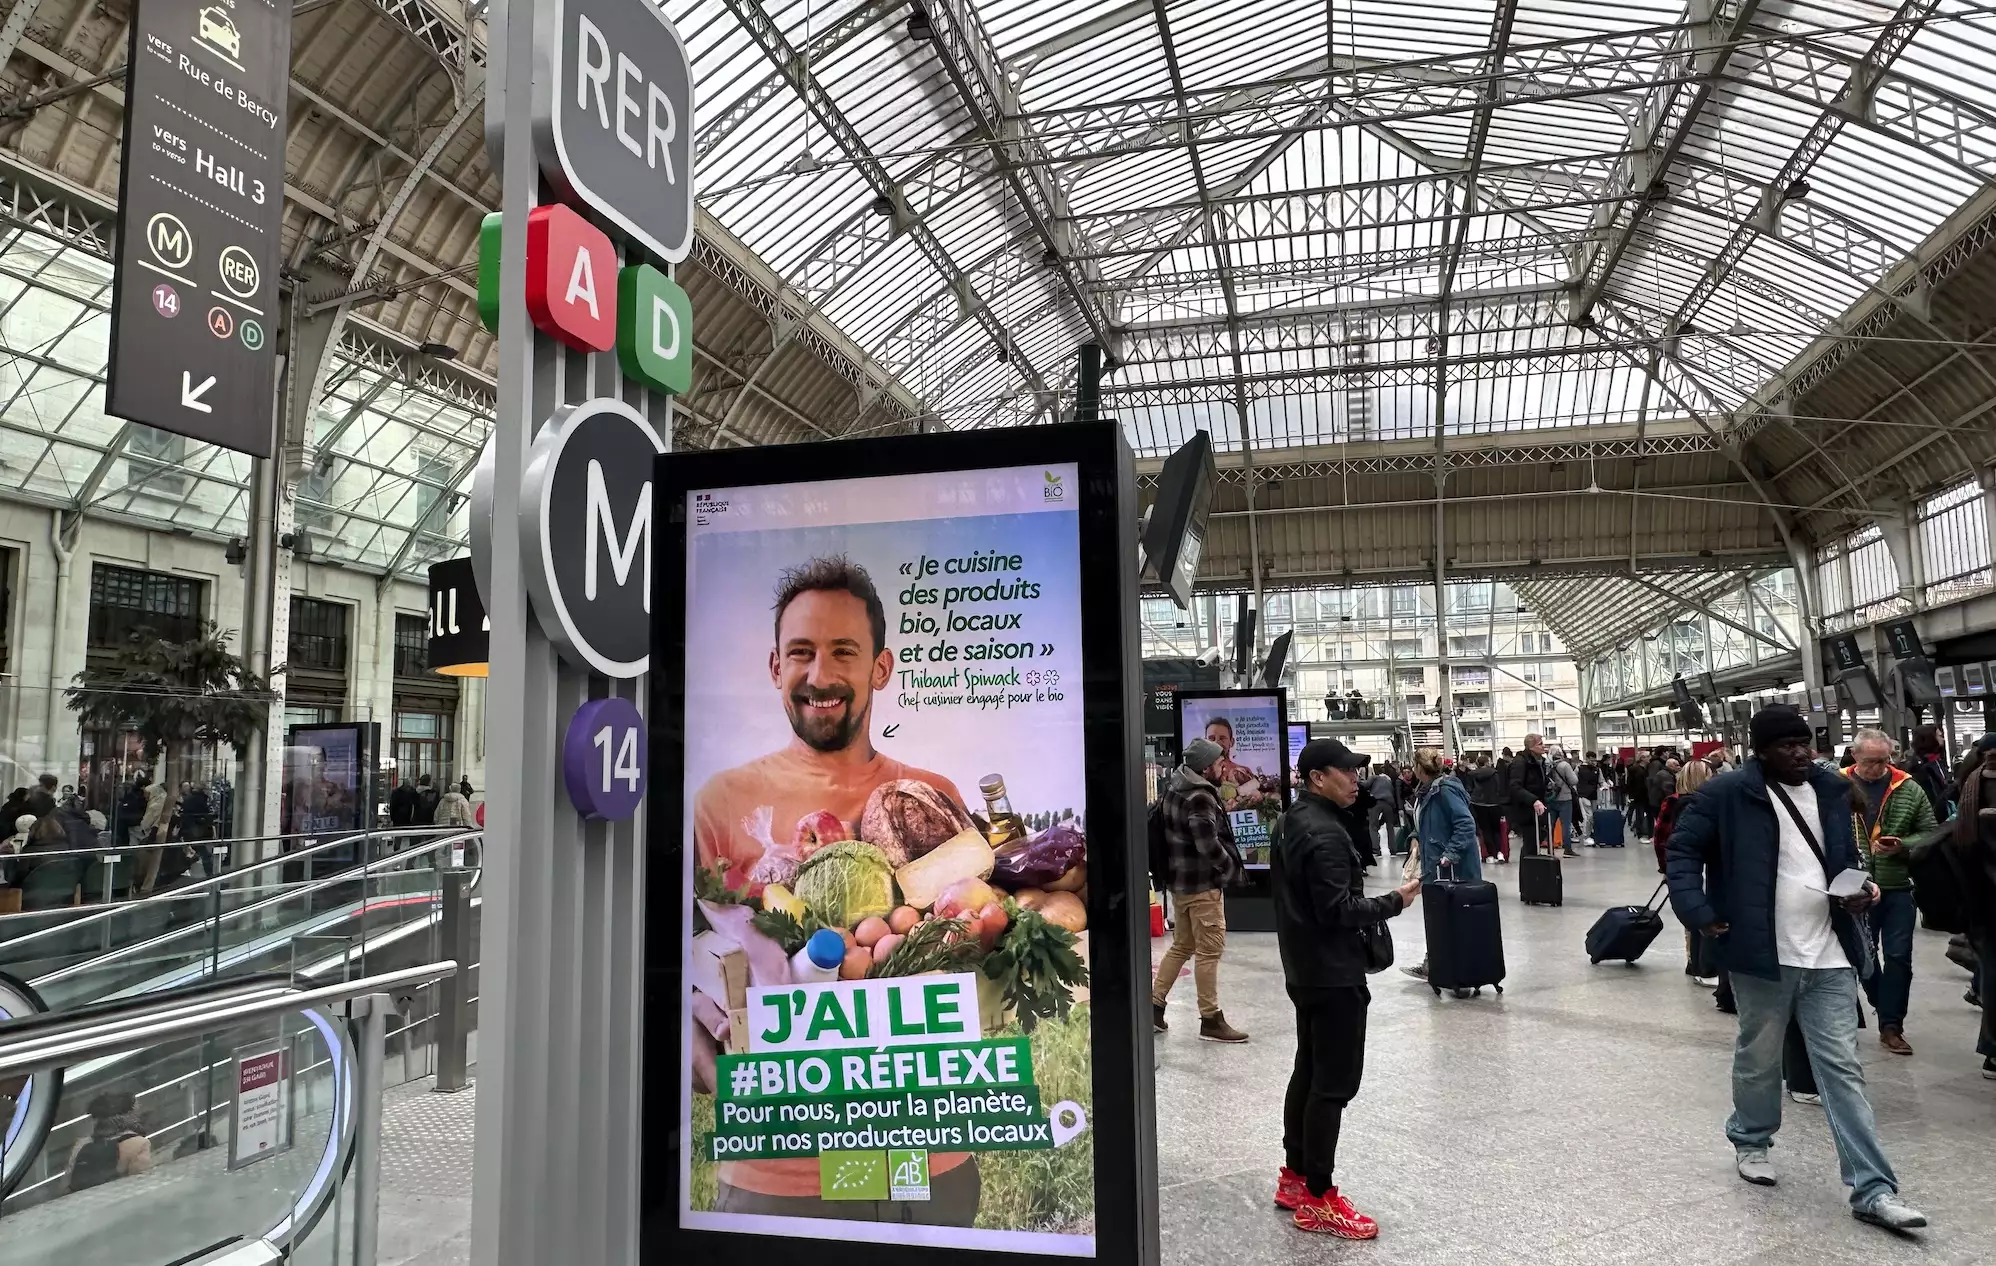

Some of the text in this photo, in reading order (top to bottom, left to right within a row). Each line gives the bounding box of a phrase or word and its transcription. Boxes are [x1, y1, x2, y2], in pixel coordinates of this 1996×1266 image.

[147, 33, 172, 54] vers
[179, 53, 278, 129] Rue de Bercy
[577, 13, 676, 186] RER
[153, 124, 187, 151] vers
[166, 150, 186, 165] verso
[196, 148, 265, 204] Hall 3
[157, 222, 182, 259] M
[225, 257, 255, 287] RER
[565, 245, 600, 321] A
[156, 289, 177, 313] 14
[214, 313, 227, 332] A
[246, 326, 258, 343] D
[653, 293, 680, 361] D
[585, 458, 652, 614] M
[914, 555, 940, 581] Je
[944, 549, 1023, 575] cuisine
[899, 577, 1041, 610] des produits
[899, 609, 1023, 637] bio, locaux
[899, 643, 924, 663] et
[928, 639, 958, 662] de
[962, 637, 1034, 661] saison
[897, 666, 1021, 697] Thibaut Spiwack
[898, 686, 1064, 712] Chef cuisinier engagé pour le bio
[594, 725, 641, 793] 14
[1235, 812, 1254, 824] LE
[761, 983, 965, 1044] J’AI LE
[730, 1046, 1020, 1097] #BIO RÉFLEXE
[723, 1088, 1033, 1126] Pour nous, pour la planète,
[713, 1119, 1049, 1160] pour nos producteurs locaux
[893, 1161, 923, 1186] AB
